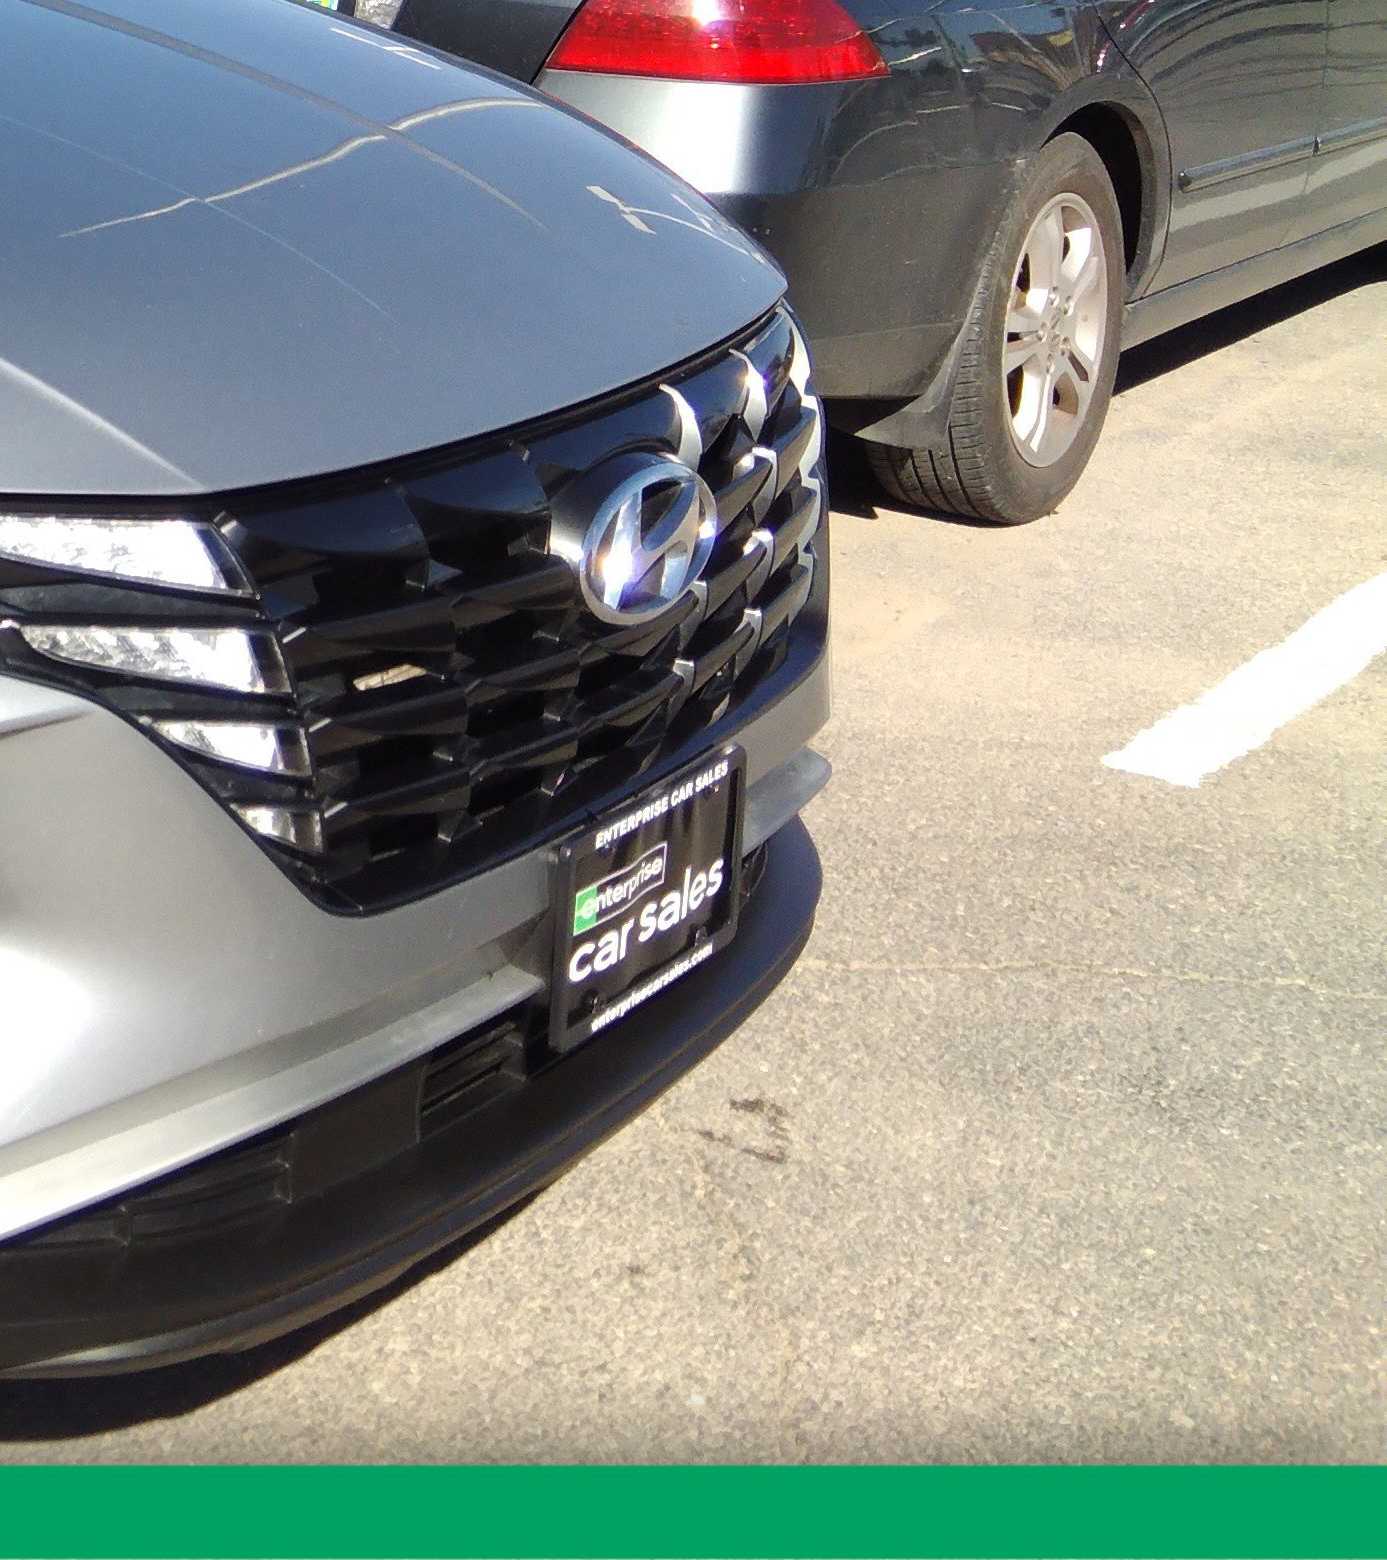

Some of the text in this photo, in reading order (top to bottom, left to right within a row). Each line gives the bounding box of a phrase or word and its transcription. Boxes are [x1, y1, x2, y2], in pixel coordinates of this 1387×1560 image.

[595, 759, 728, 850] ENTERPRISE CAR SALES
[569, 858, 725, 982] car sales
[578, 856, 663, 919] enterprise
[591, 943, 713, 1033] enterprisecarsales.com
